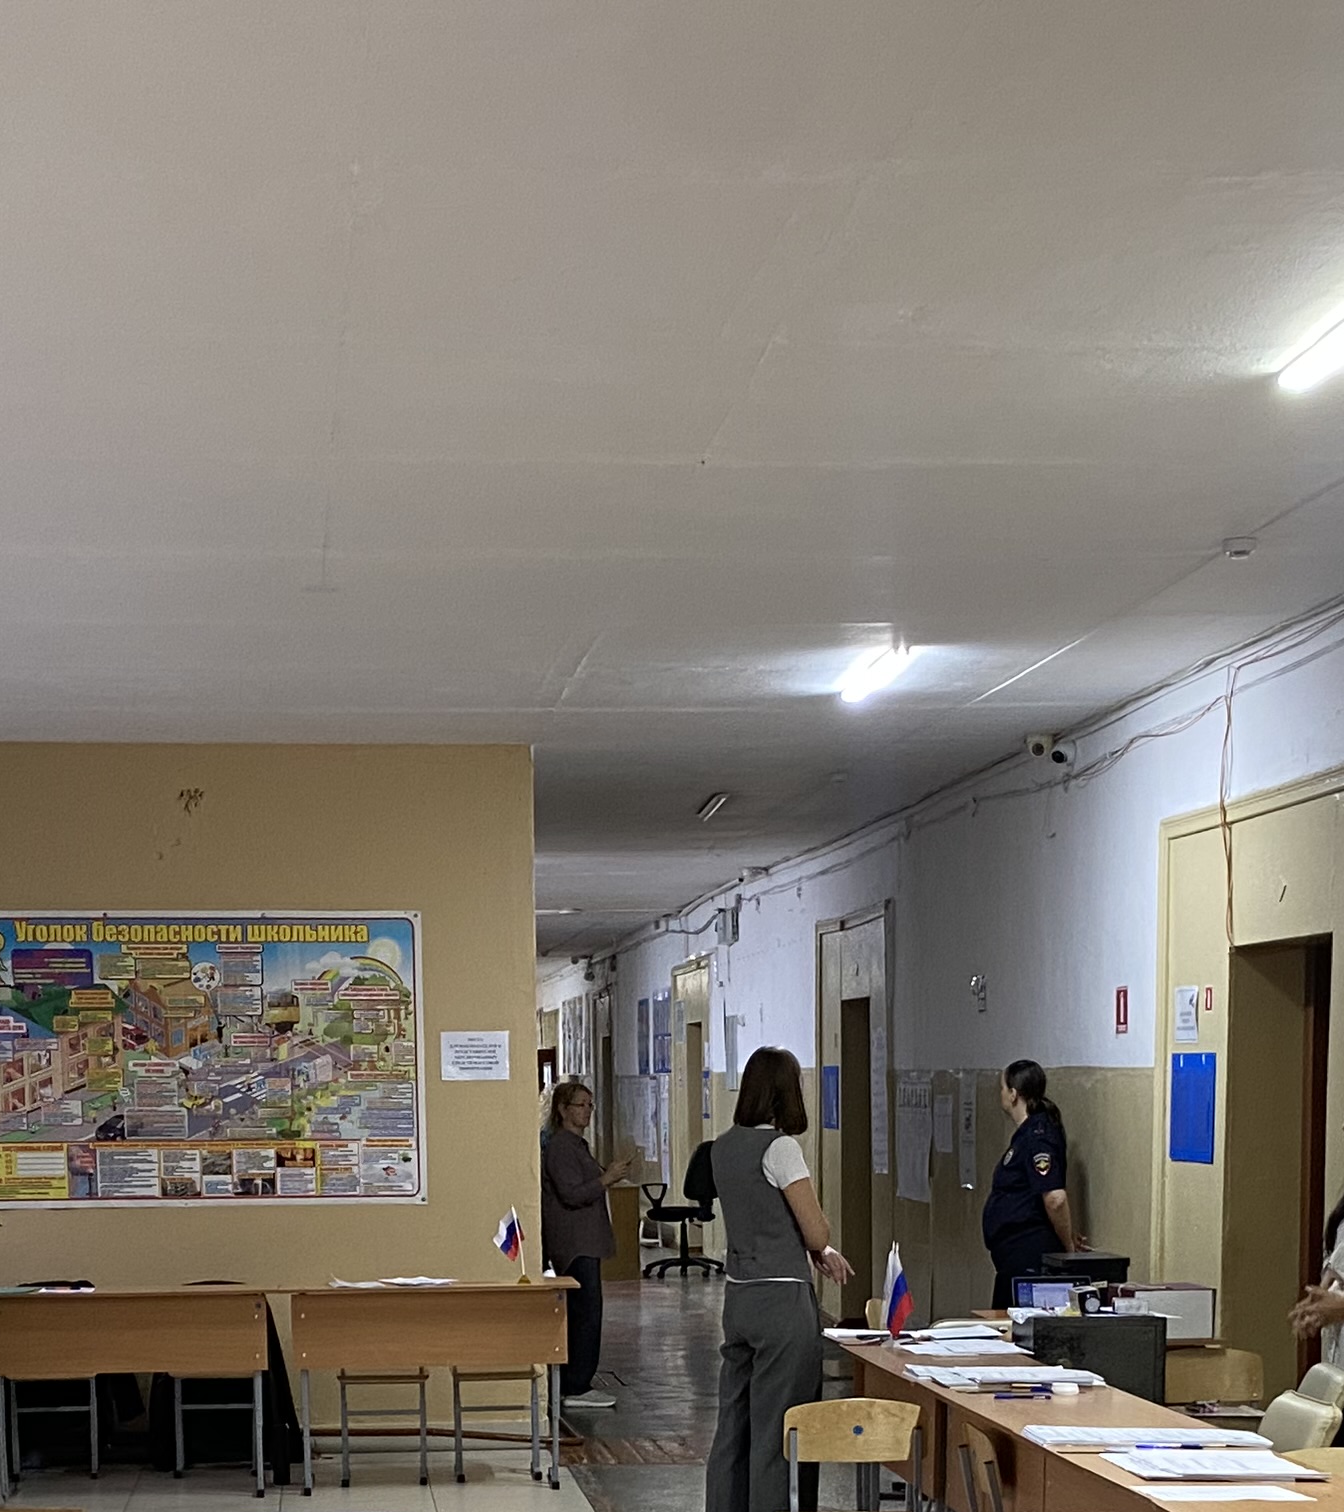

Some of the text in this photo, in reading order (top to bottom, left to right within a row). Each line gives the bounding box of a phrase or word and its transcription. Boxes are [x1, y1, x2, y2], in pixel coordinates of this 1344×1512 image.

[13, 920, 369, 943] Уголок безопасности школьника
